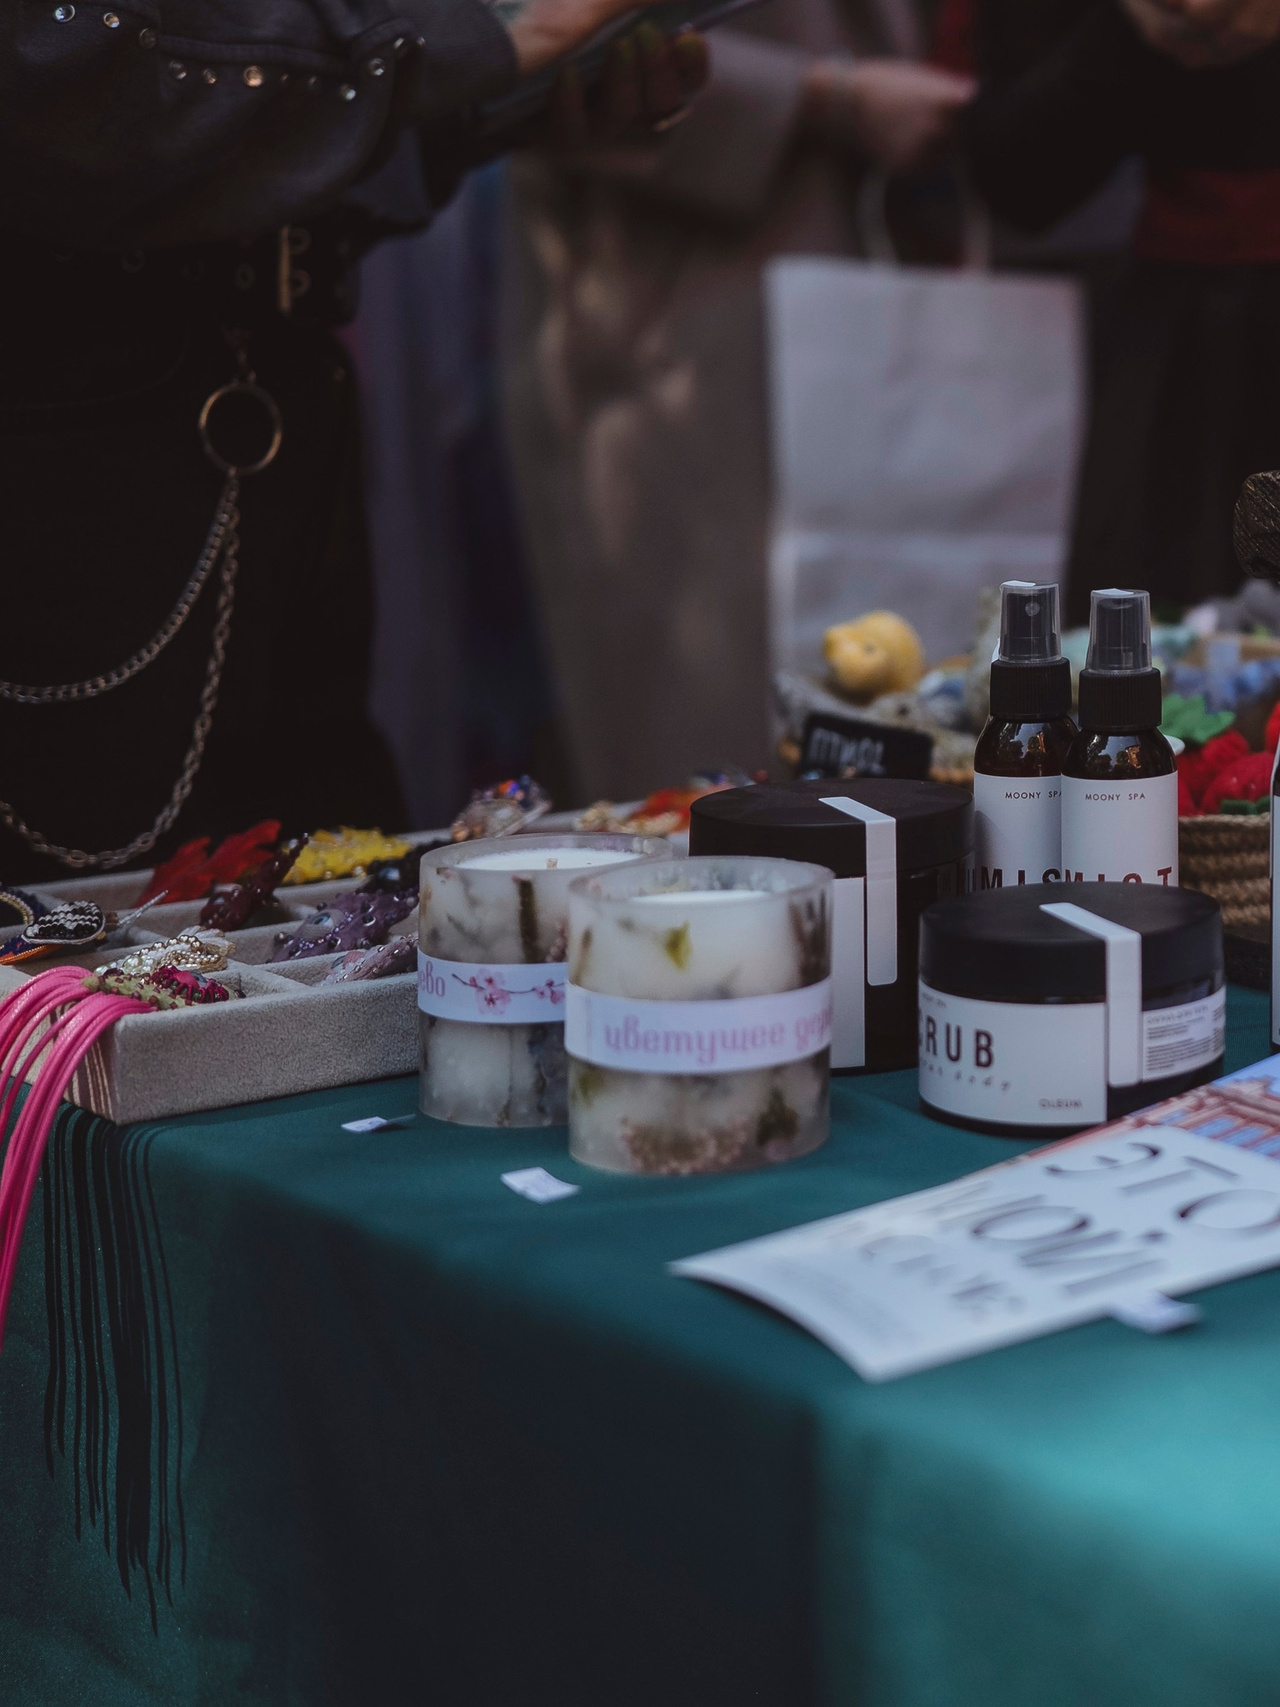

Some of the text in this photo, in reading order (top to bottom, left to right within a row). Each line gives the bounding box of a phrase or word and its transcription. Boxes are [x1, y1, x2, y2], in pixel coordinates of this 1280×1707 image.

[1005, 791, 1041, 799] MOONY
[1085, 792, 1146, 801] MOONY SPA
[604, 1013, 785, 1067] цветущее
